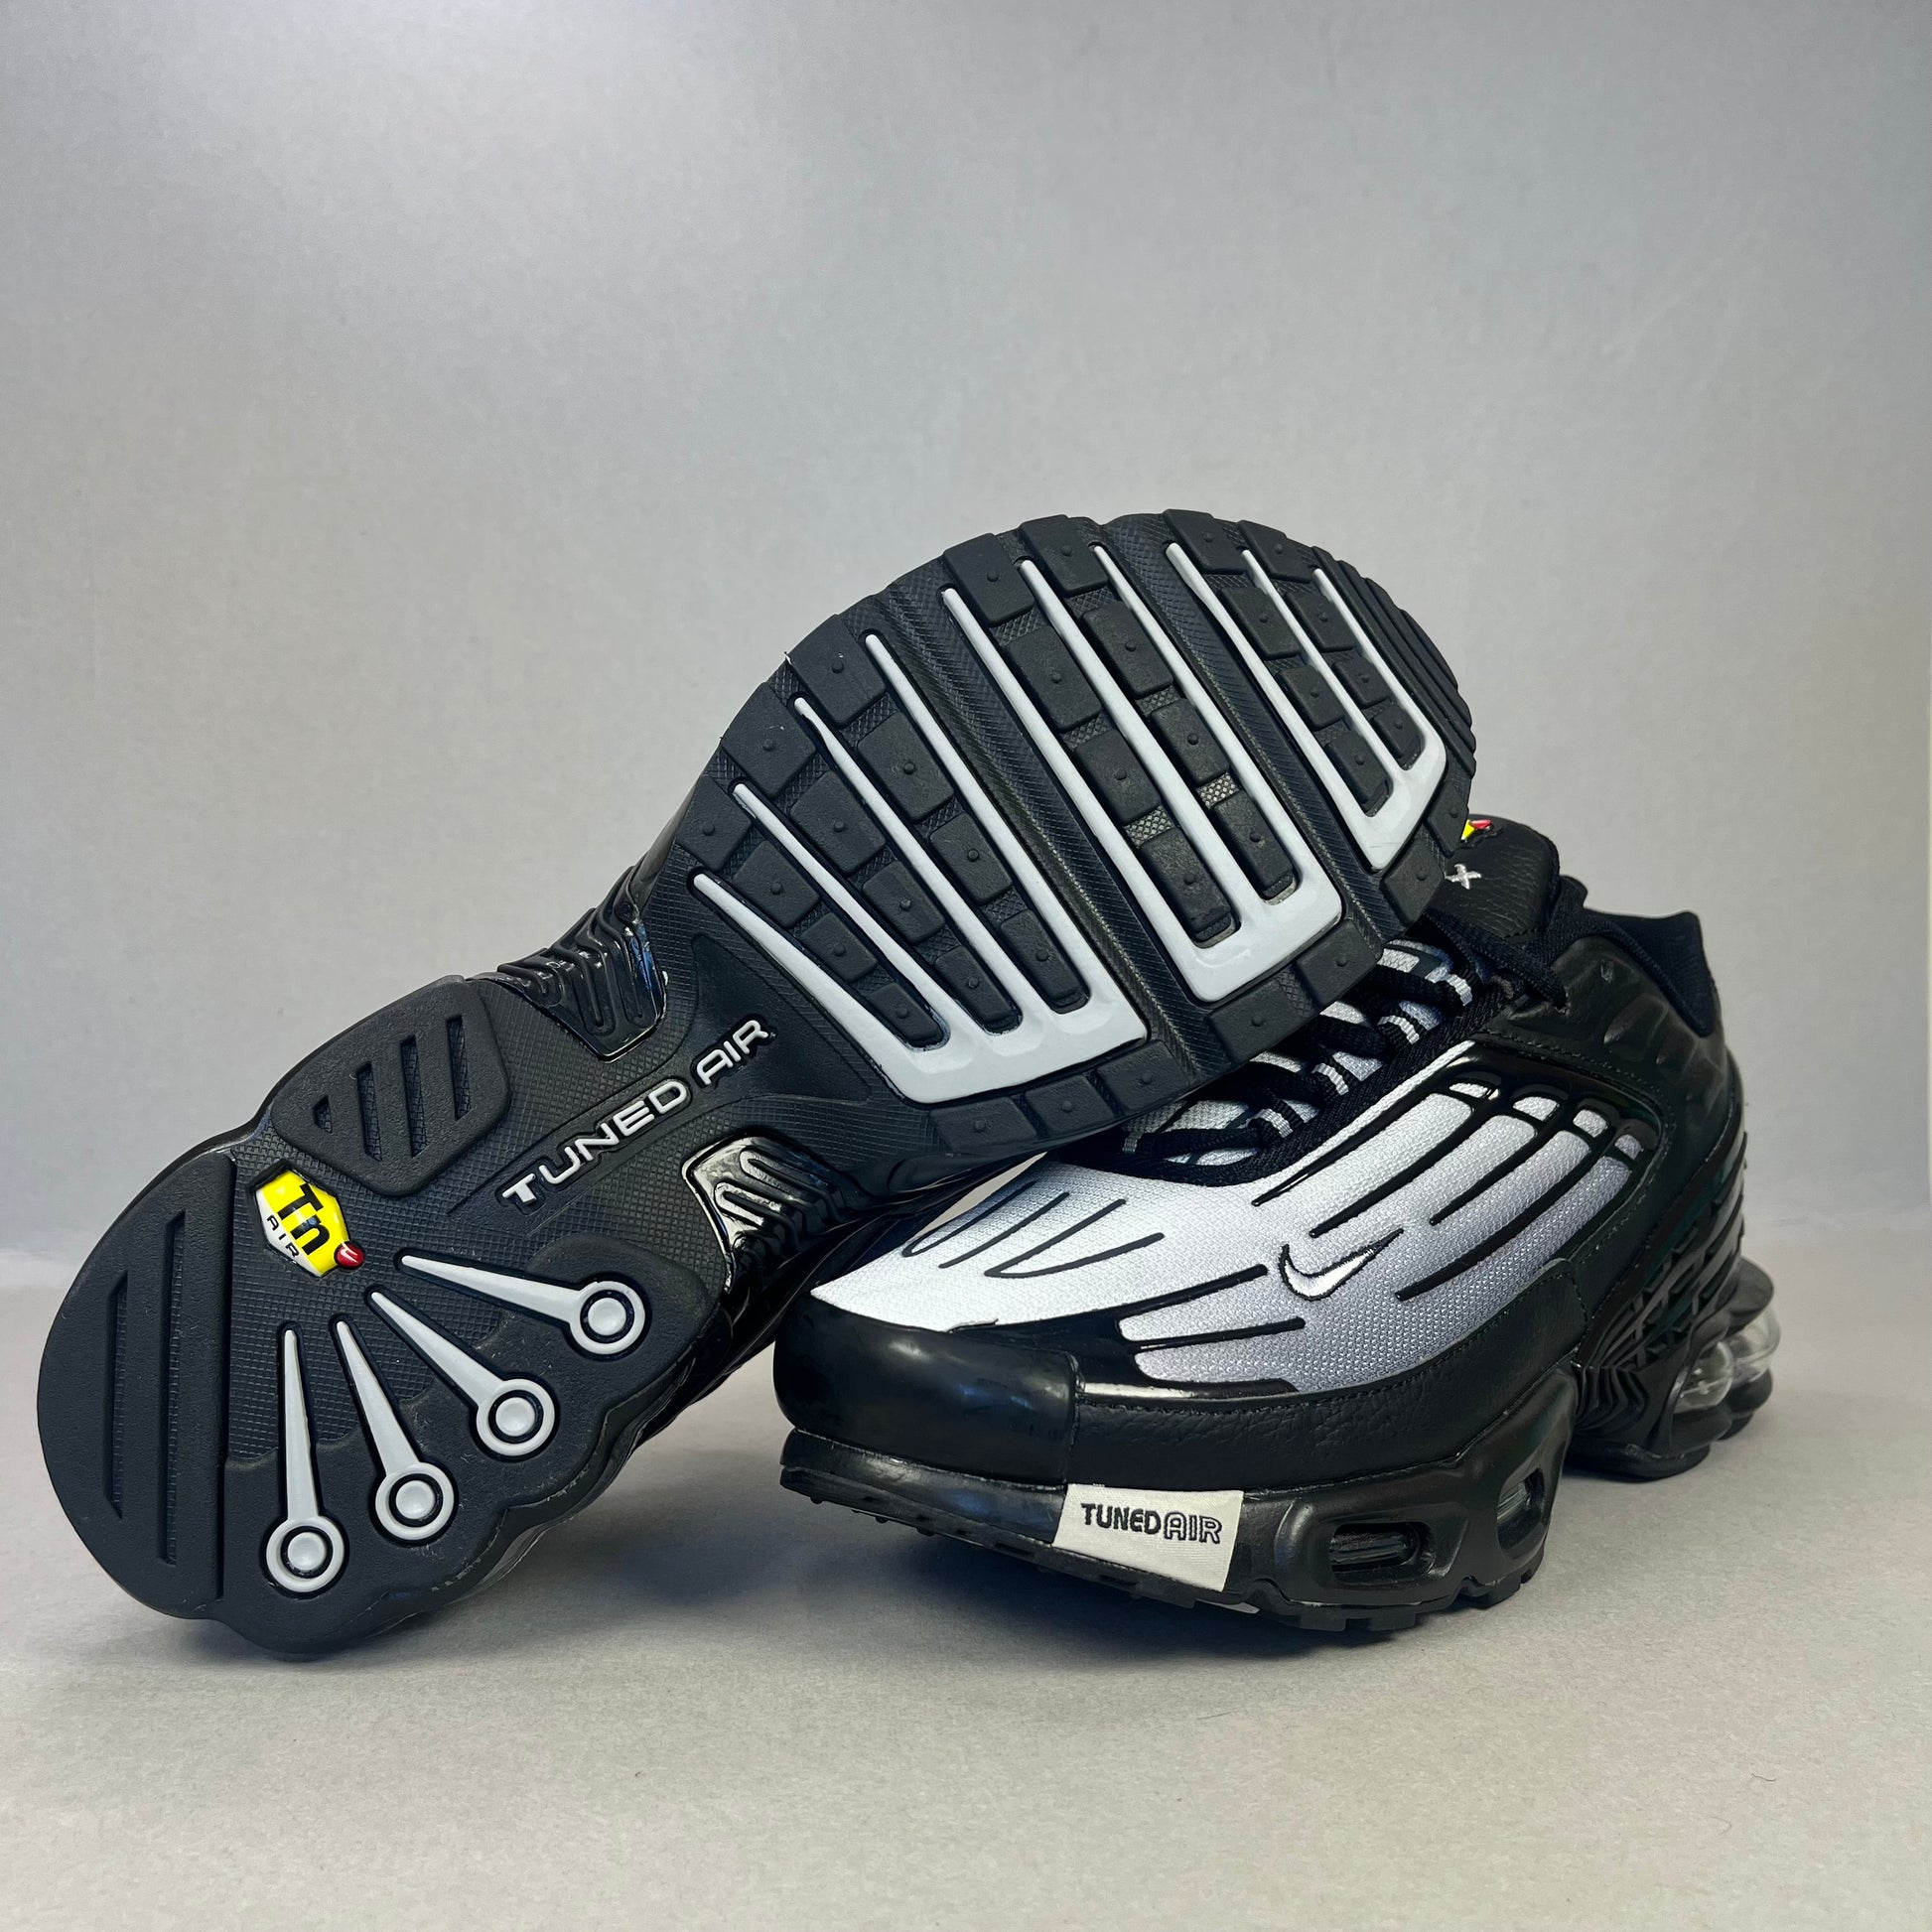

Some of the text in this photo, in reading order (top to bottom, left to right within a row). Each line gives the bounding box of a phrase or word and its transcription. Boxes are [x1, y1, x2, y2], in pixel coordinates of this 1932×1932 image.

[502, 1020, 768, 1204] TUNED AIR
[266, 1214, 300, 1258] AIR
